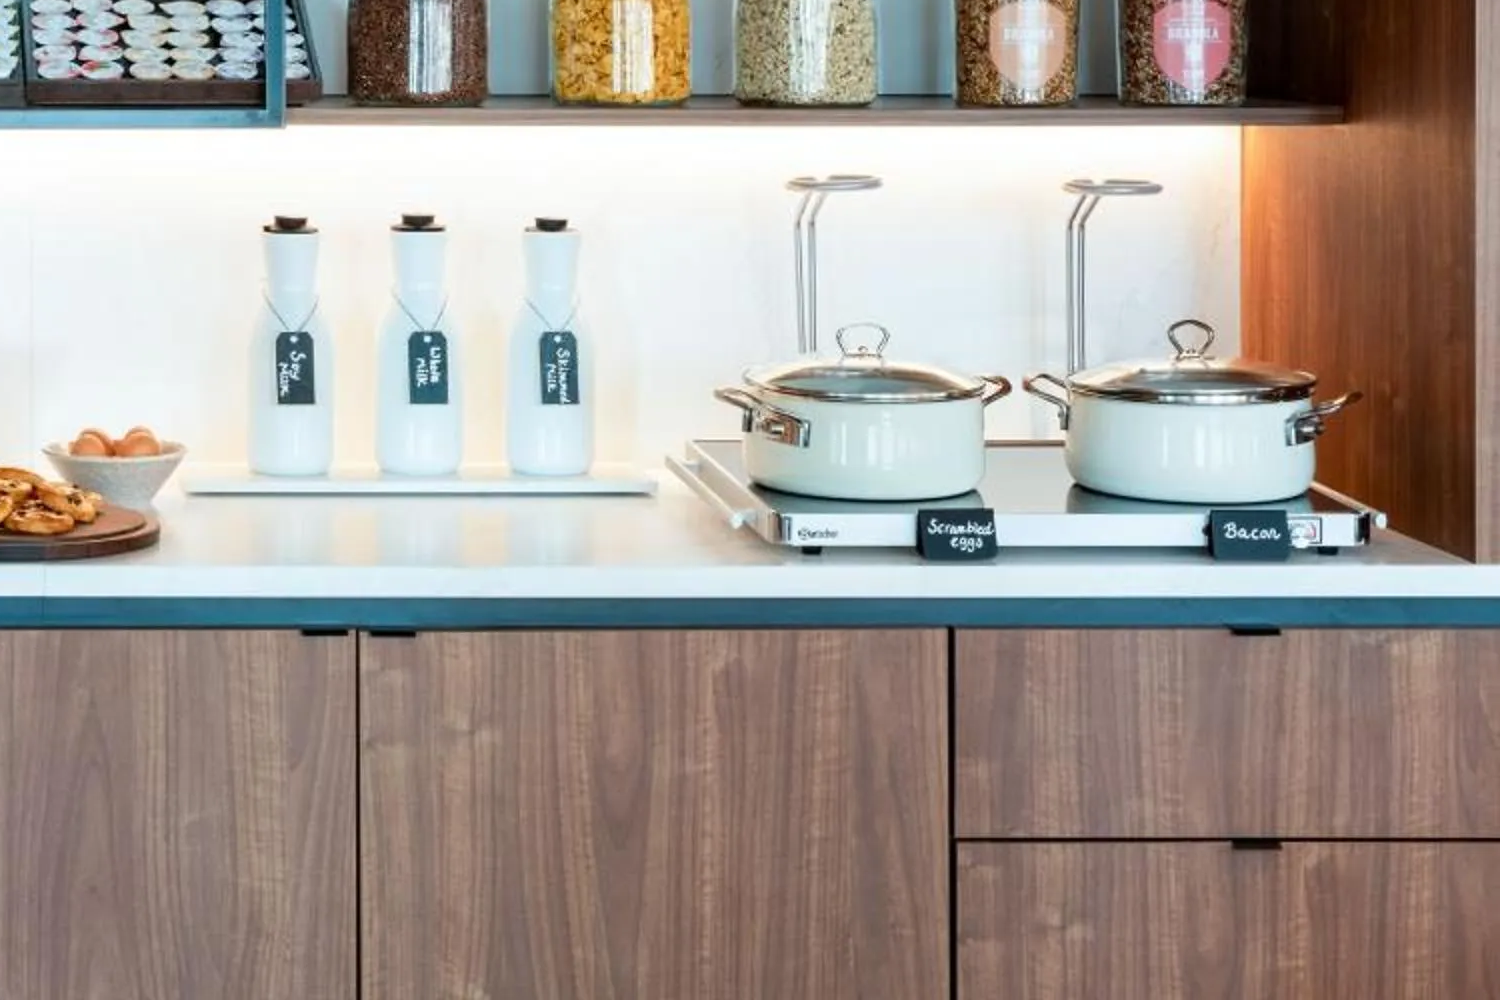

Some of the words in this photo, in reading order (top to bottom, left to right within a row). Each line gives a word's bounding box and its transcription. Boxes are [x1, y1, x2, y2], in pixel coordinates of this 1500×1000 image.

[289, 350, 307, 382] Soy
[926, 517, 995, 536] Scrambled
[1223, 521, 1281, 540] Bacon
[950, 535, 984, 552] eggs
